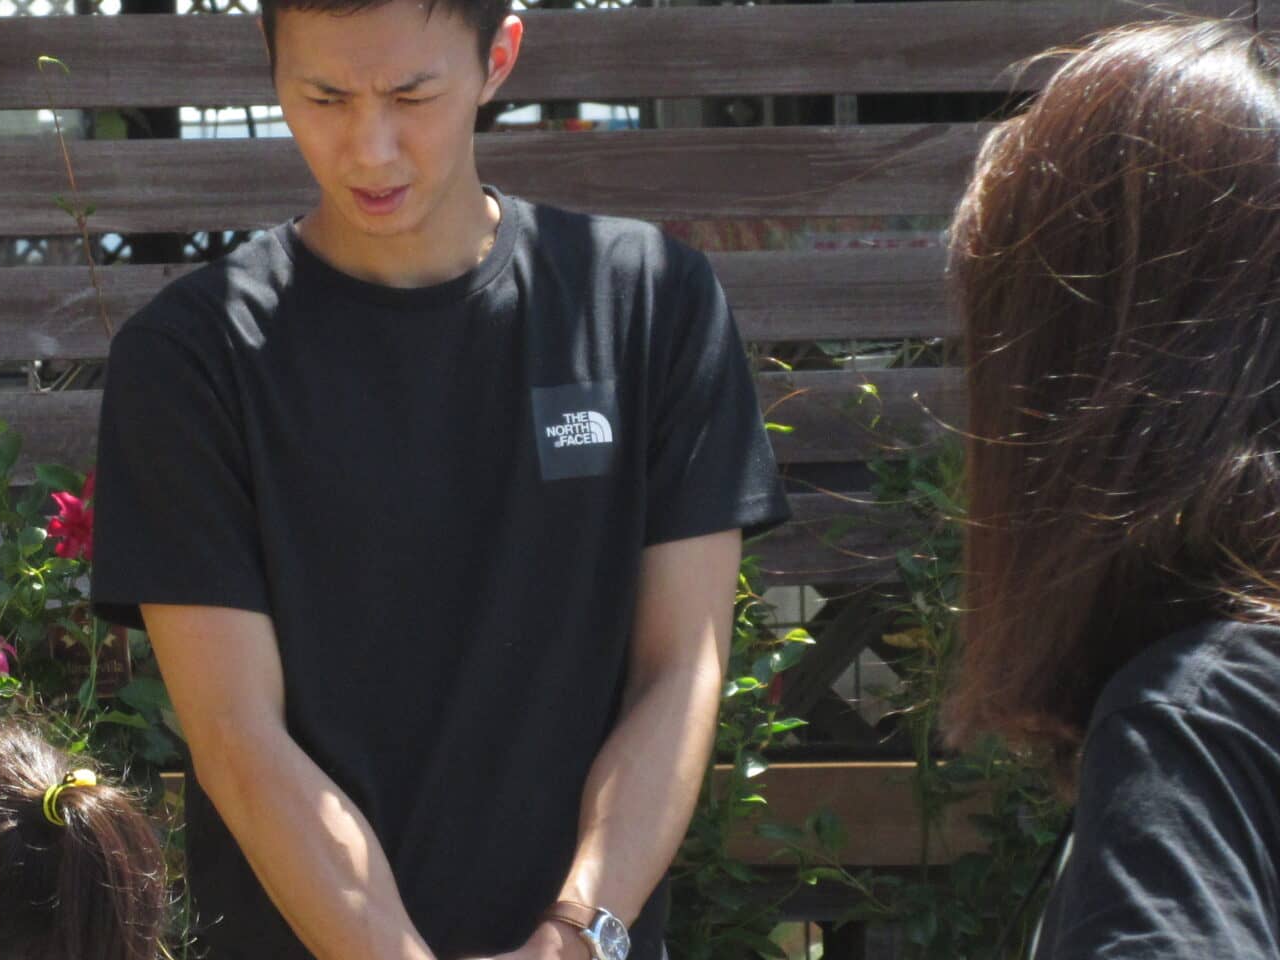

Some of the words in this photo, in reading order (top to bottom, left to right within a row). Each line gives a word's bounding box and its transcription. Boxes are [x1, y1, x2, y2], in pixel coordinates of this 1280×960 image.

[562, 411, 589, 423] THE
[546, 422, 590, 437] NORTH
[560, 433, 592, 447] FACE
